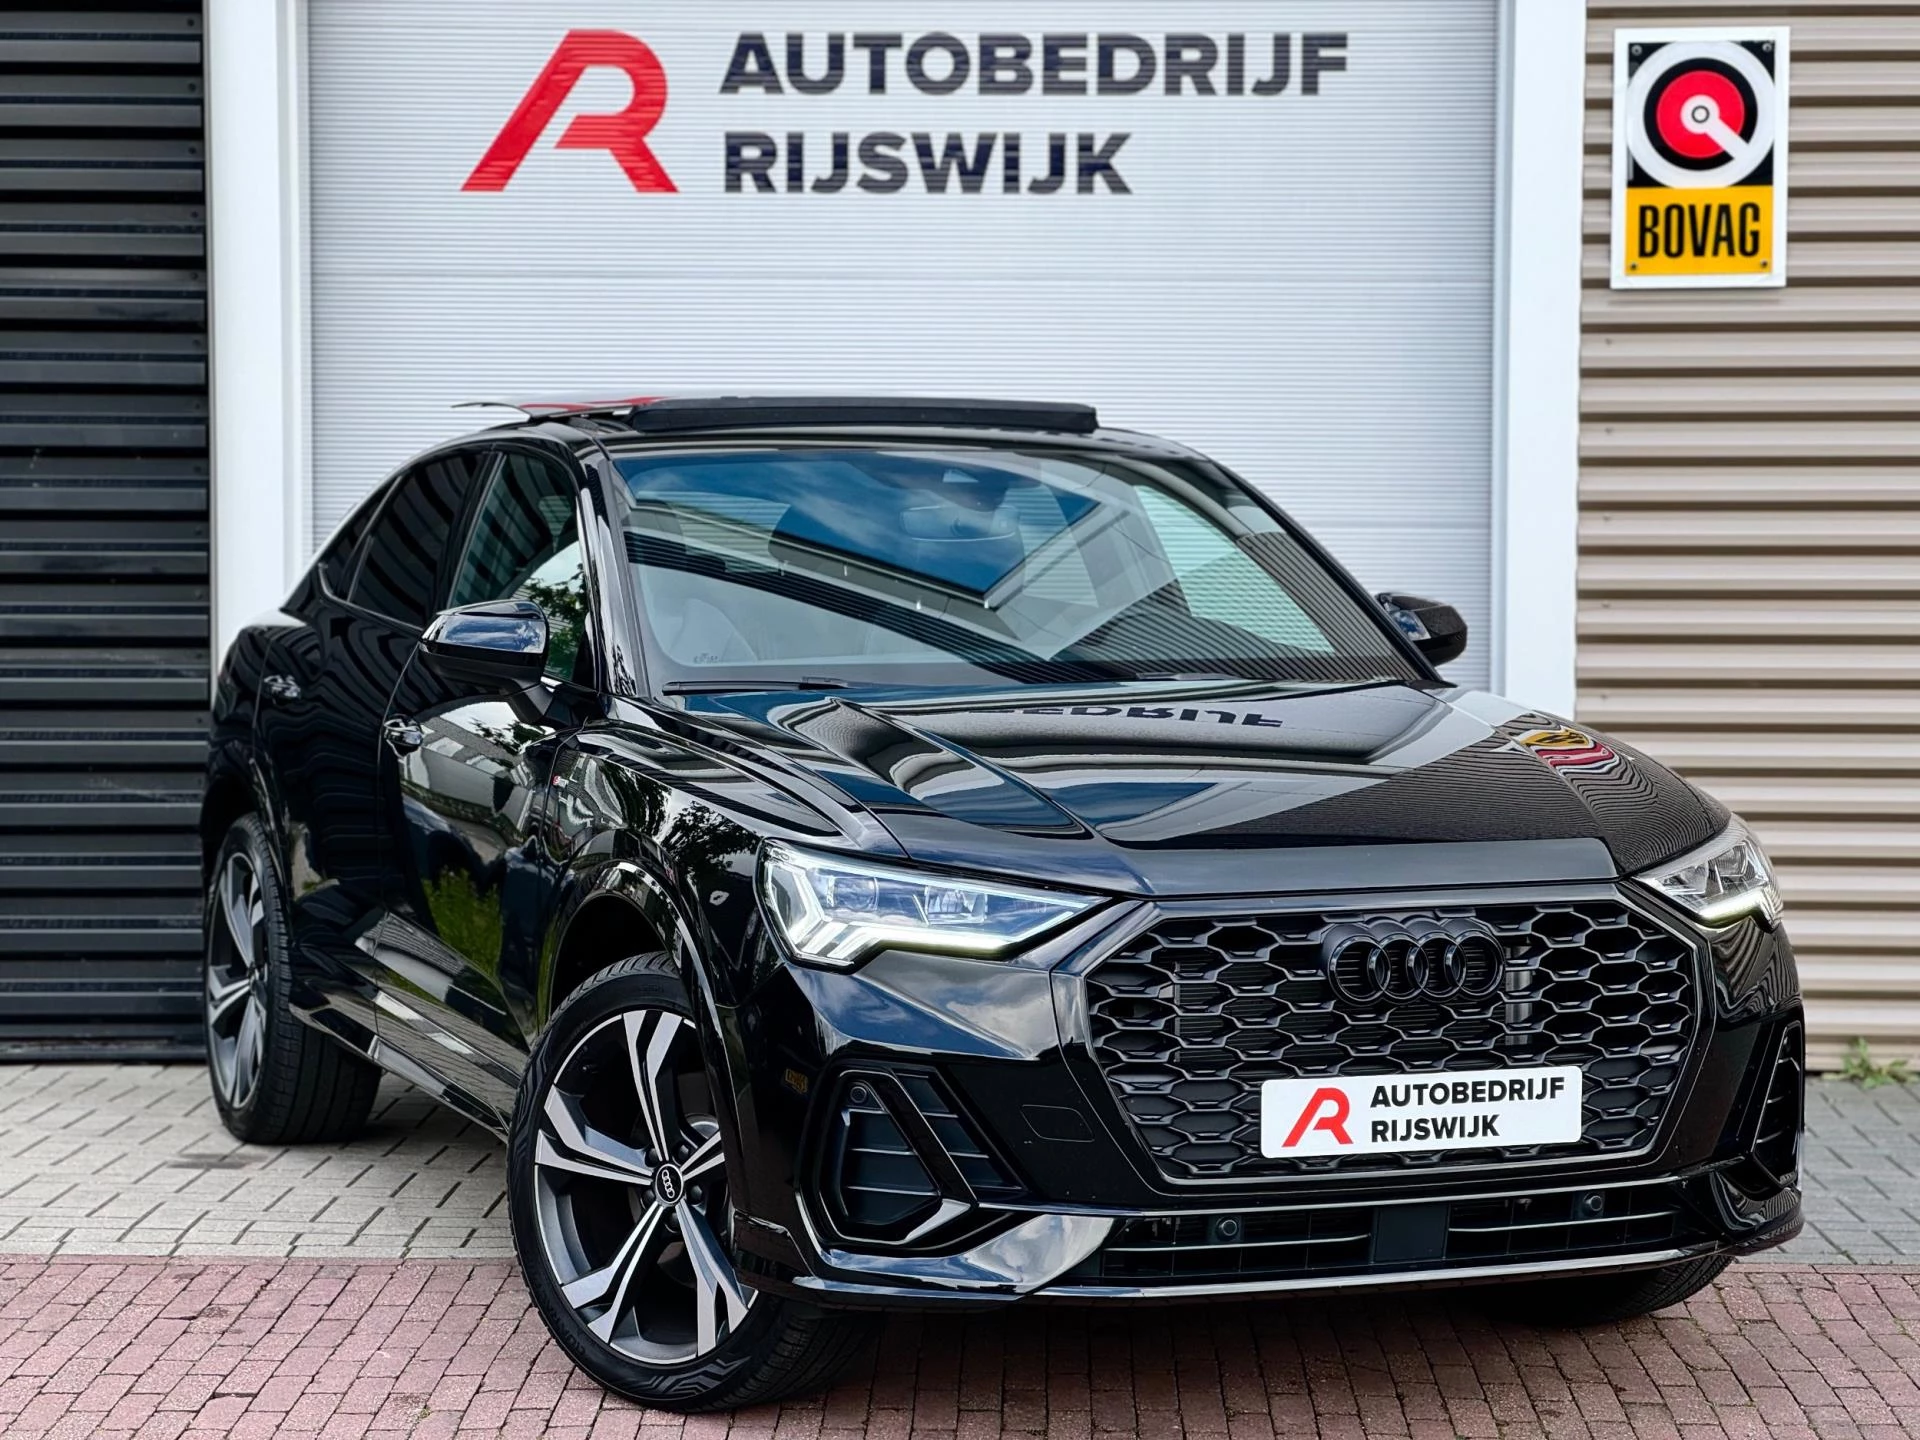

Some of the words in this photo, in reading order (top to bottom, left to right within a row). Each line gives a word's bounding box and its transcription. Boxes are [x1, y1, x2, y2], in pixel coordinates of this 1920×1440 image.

[720, 32, 1348, 97] AUTOBEDRIJF
[724, 131, 1131, 195] RIJSWIJK
[1638, 202, 1761, 259] BOVAG
[1370, 1076, 1565, 1109] AUTOBEDRIJF
[1370, 1114, 1500, 1144] RIJSWIJK
